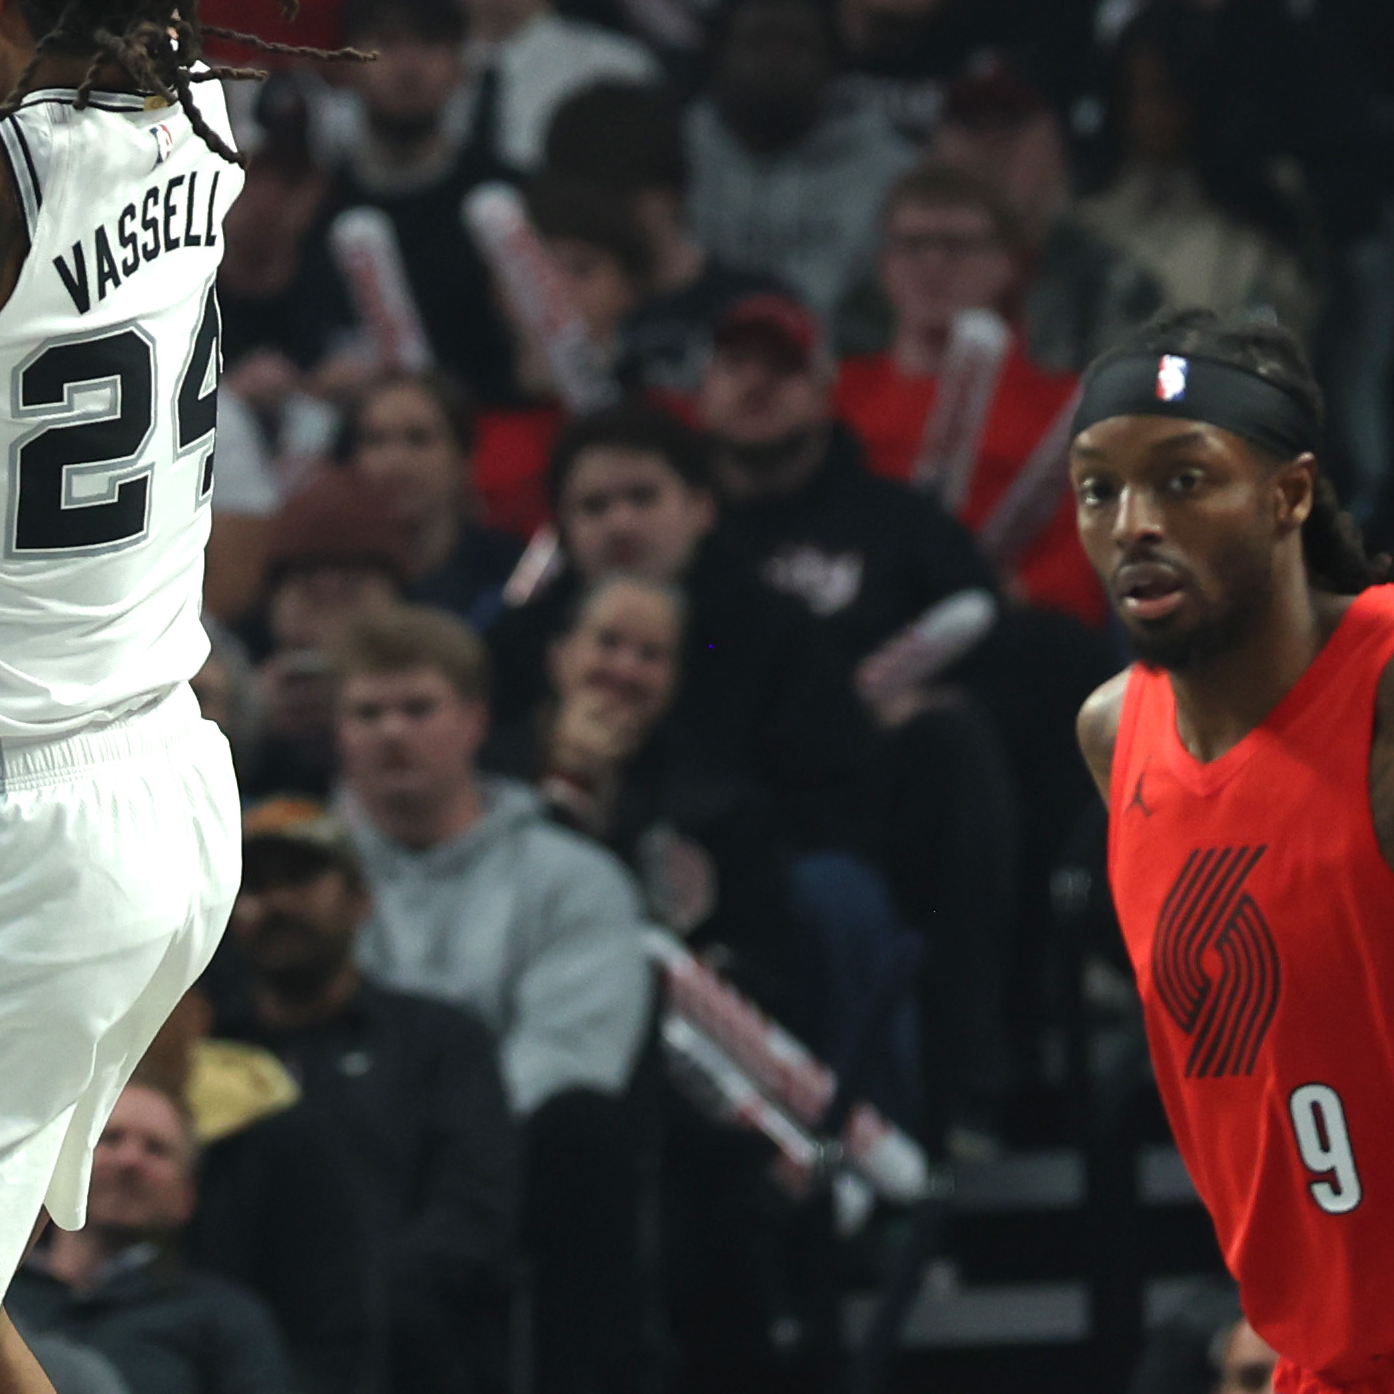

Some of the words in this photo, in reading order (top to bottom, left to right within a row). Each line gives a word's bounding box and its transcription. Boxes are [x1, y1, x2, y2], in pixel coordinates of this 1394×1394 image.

[52, 169, 221, 316] VASSELL
[4, 268, 220, 559] 24
[1288, 1080, 1364, 1215] 9
